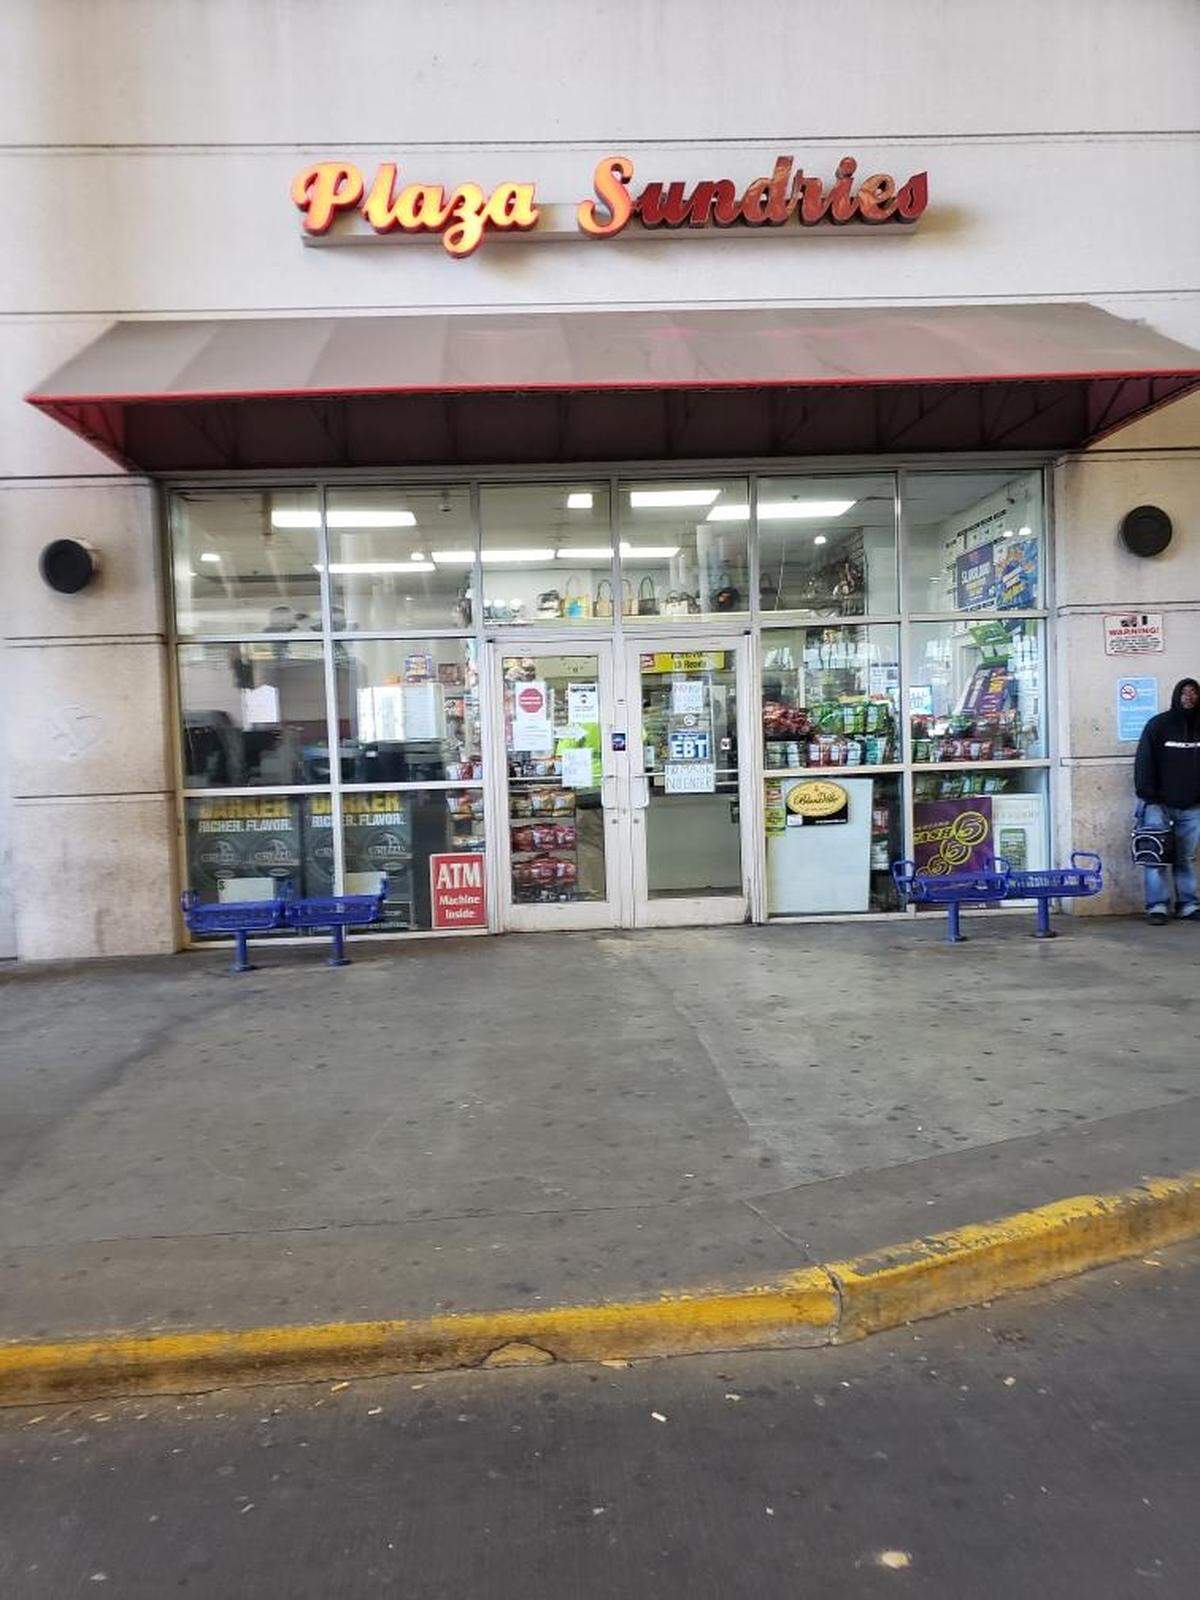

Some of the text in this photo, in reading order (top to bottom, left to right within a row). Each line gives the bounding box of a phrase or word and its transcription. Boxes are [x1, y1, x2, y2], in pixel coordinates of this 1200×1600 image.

[291, 155, 930, 259] Plaza Sundries
[671, 740, 707, 758] EBT
[436, 862, 482, 889] ATM
[439, 894, 481, 906] Machine
